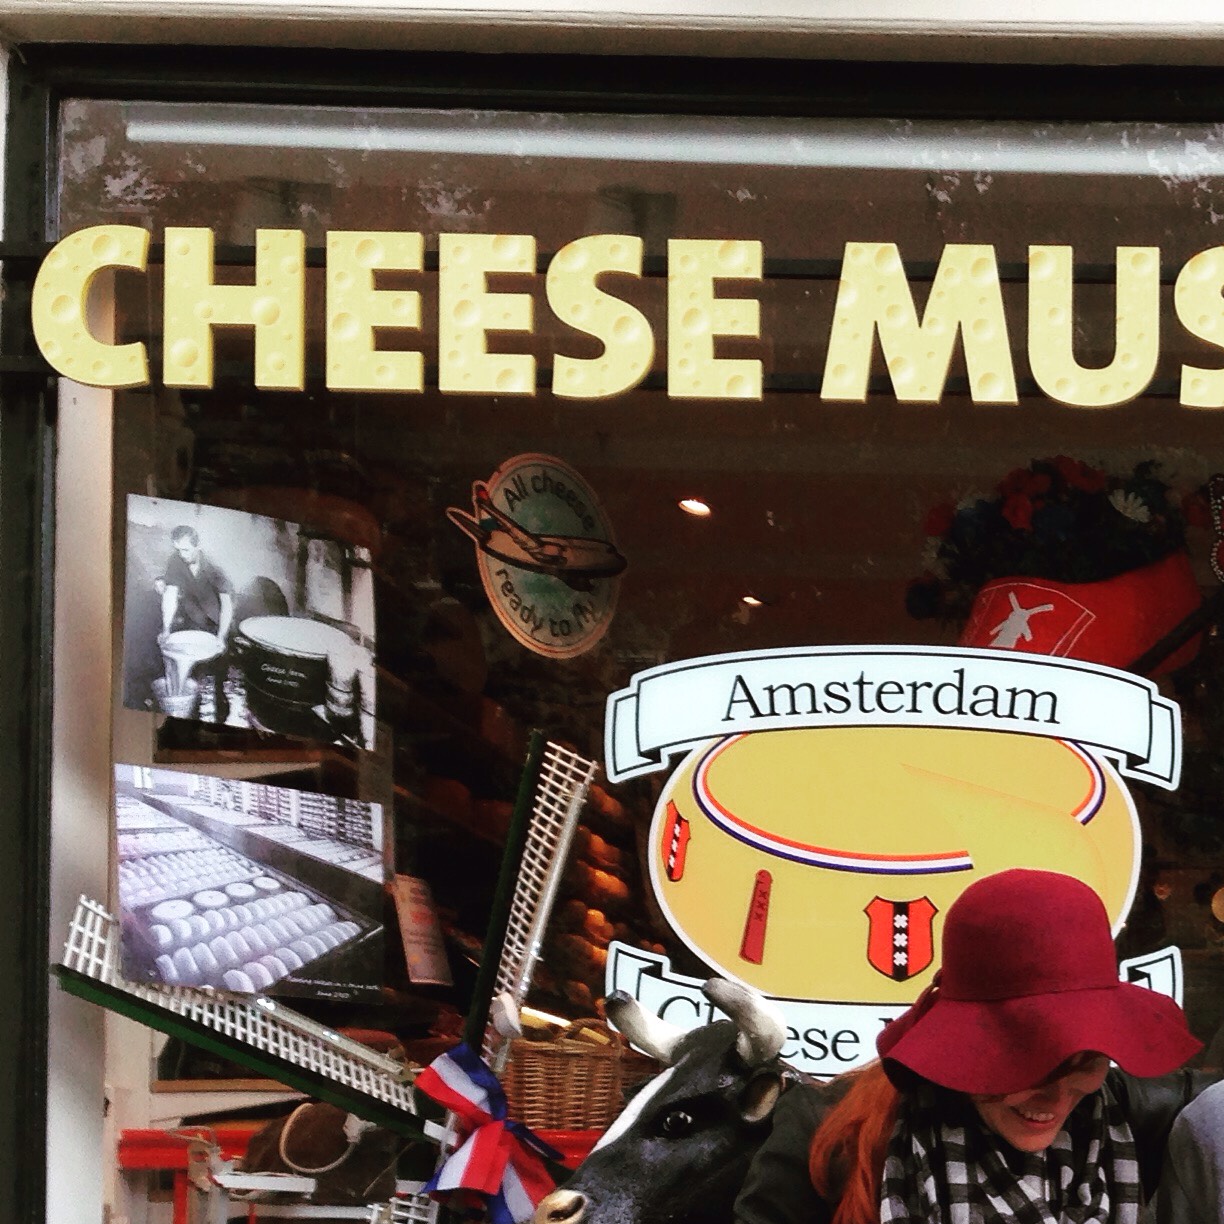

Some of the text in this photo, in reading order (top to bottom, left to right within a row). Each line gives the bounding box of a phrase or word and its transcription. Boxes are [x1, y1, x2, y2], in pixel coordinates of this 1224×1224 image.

[31, 224, 764, 399] CHEESE
[503, 469, 596, 531] All cheese
[495, 568, 599, 637] ready to fly
[721, 668, 1061, 725] Amsterdam
[656, 995, 860, 1062] Cese
